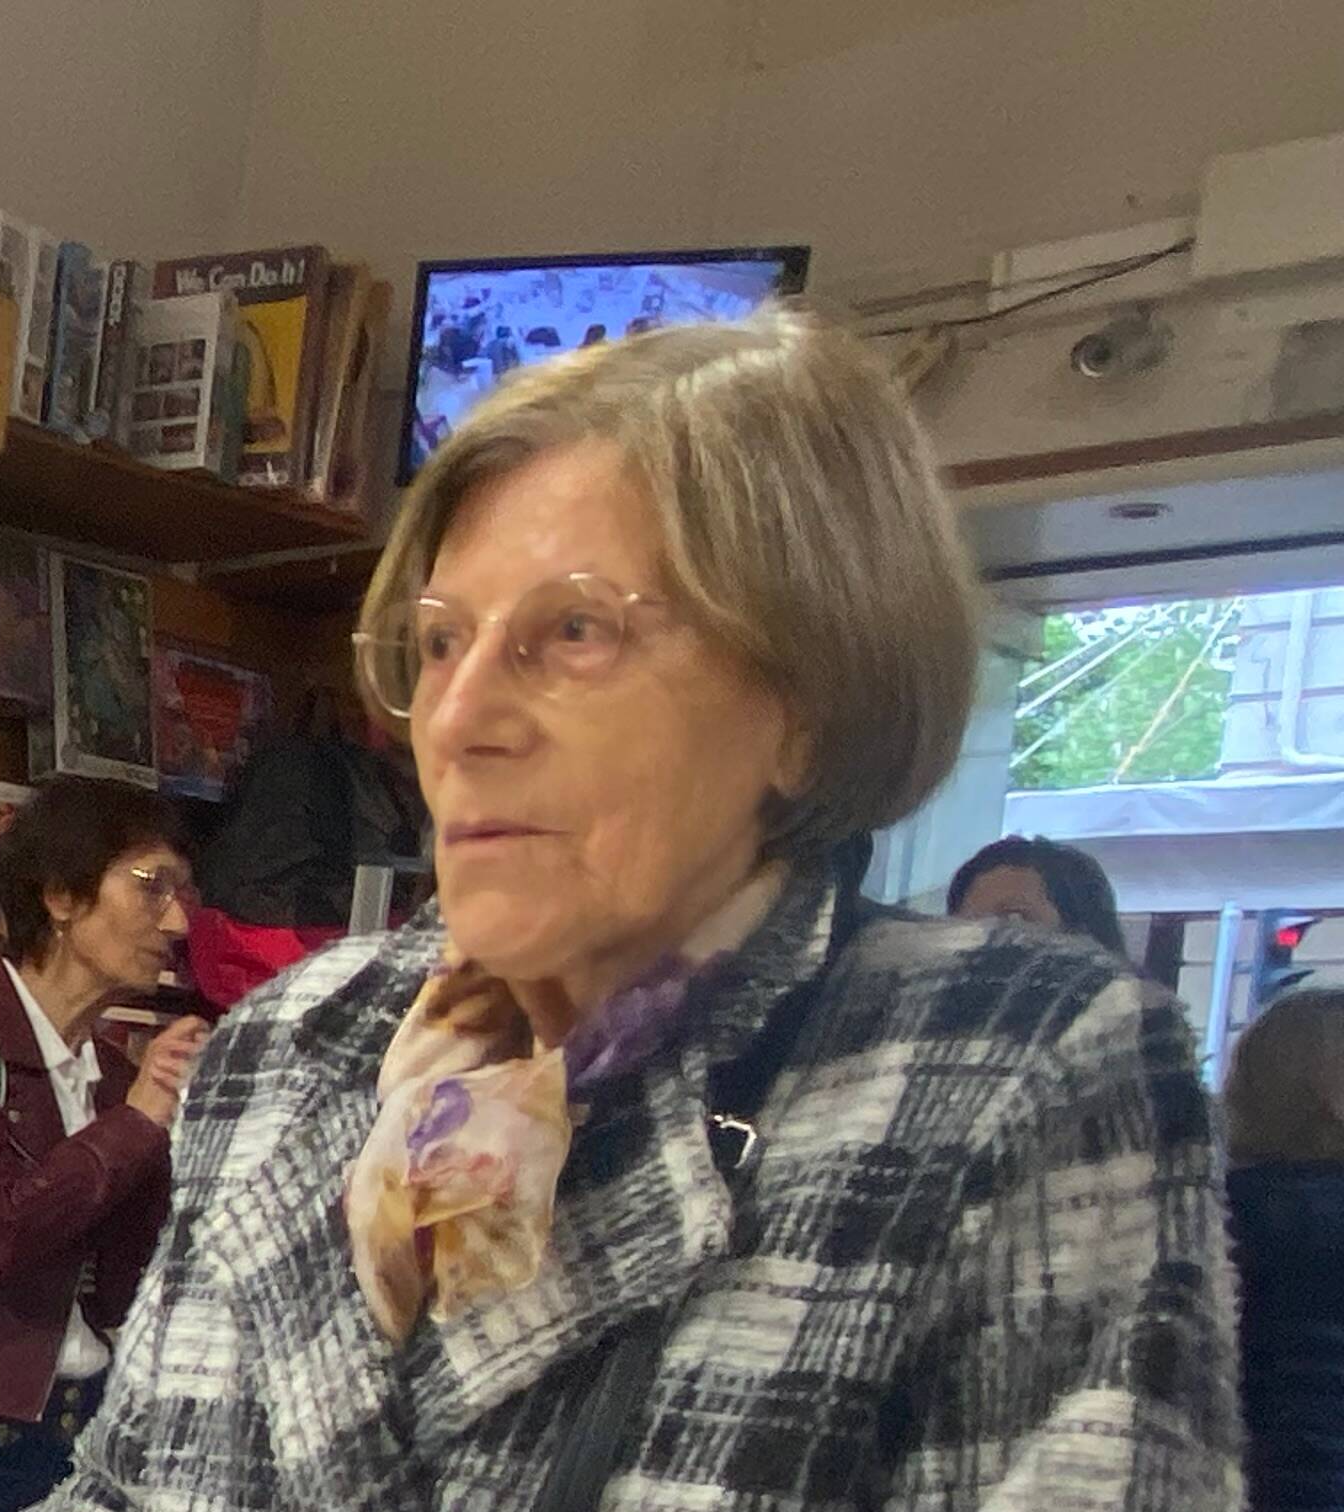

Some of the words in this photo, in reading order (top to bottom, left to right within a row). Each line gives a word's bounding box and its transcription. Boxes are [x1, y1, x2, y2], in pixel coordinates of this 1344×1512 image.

[176, 268, 207, 293] We
[209, 266, 245, 290] Can
[250, 261, 277, 286] Do
[282, 258, 305, 285] It!
